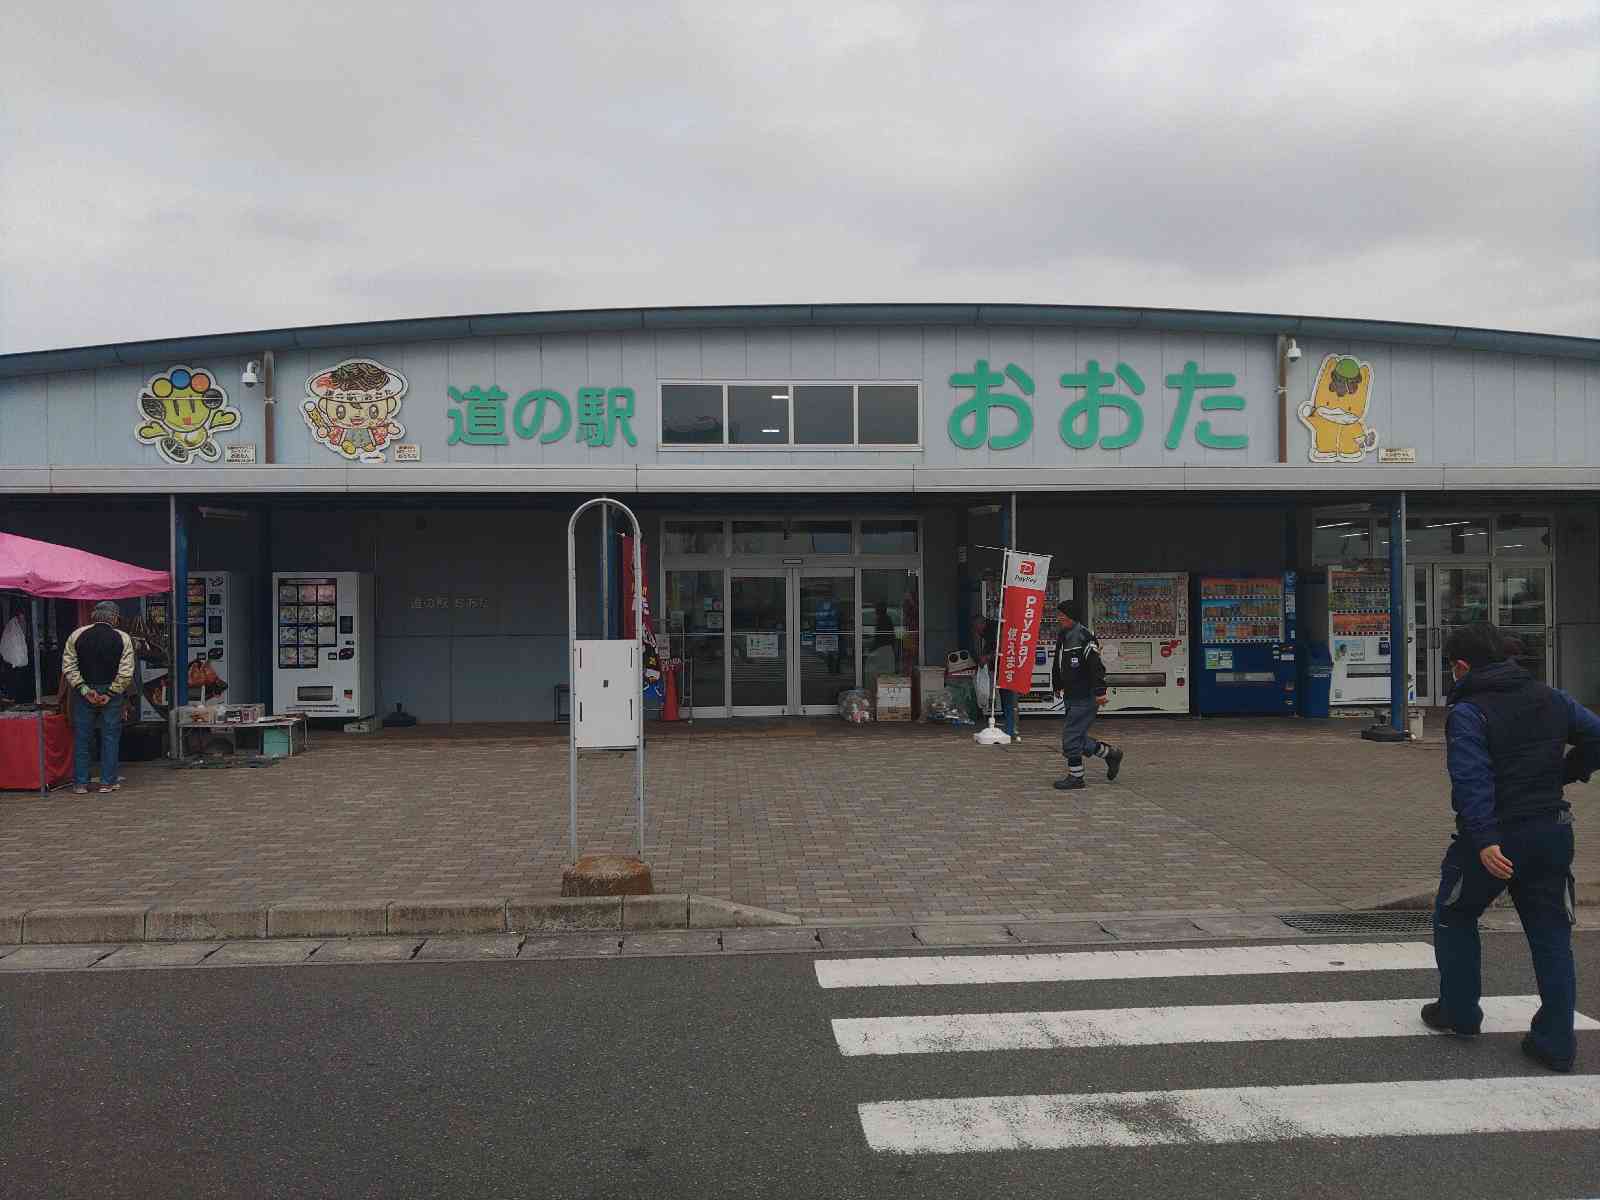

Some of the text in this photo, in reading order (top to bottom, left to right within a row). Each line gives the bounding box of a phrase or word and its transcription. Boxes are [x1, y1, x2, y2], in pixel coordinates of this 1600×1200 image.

[448, 360, 1249, 449] 道の駅 おおた
[1005, 627, 1018, 683] 使えます
[1018, 596, 1037, 668] PayPay
